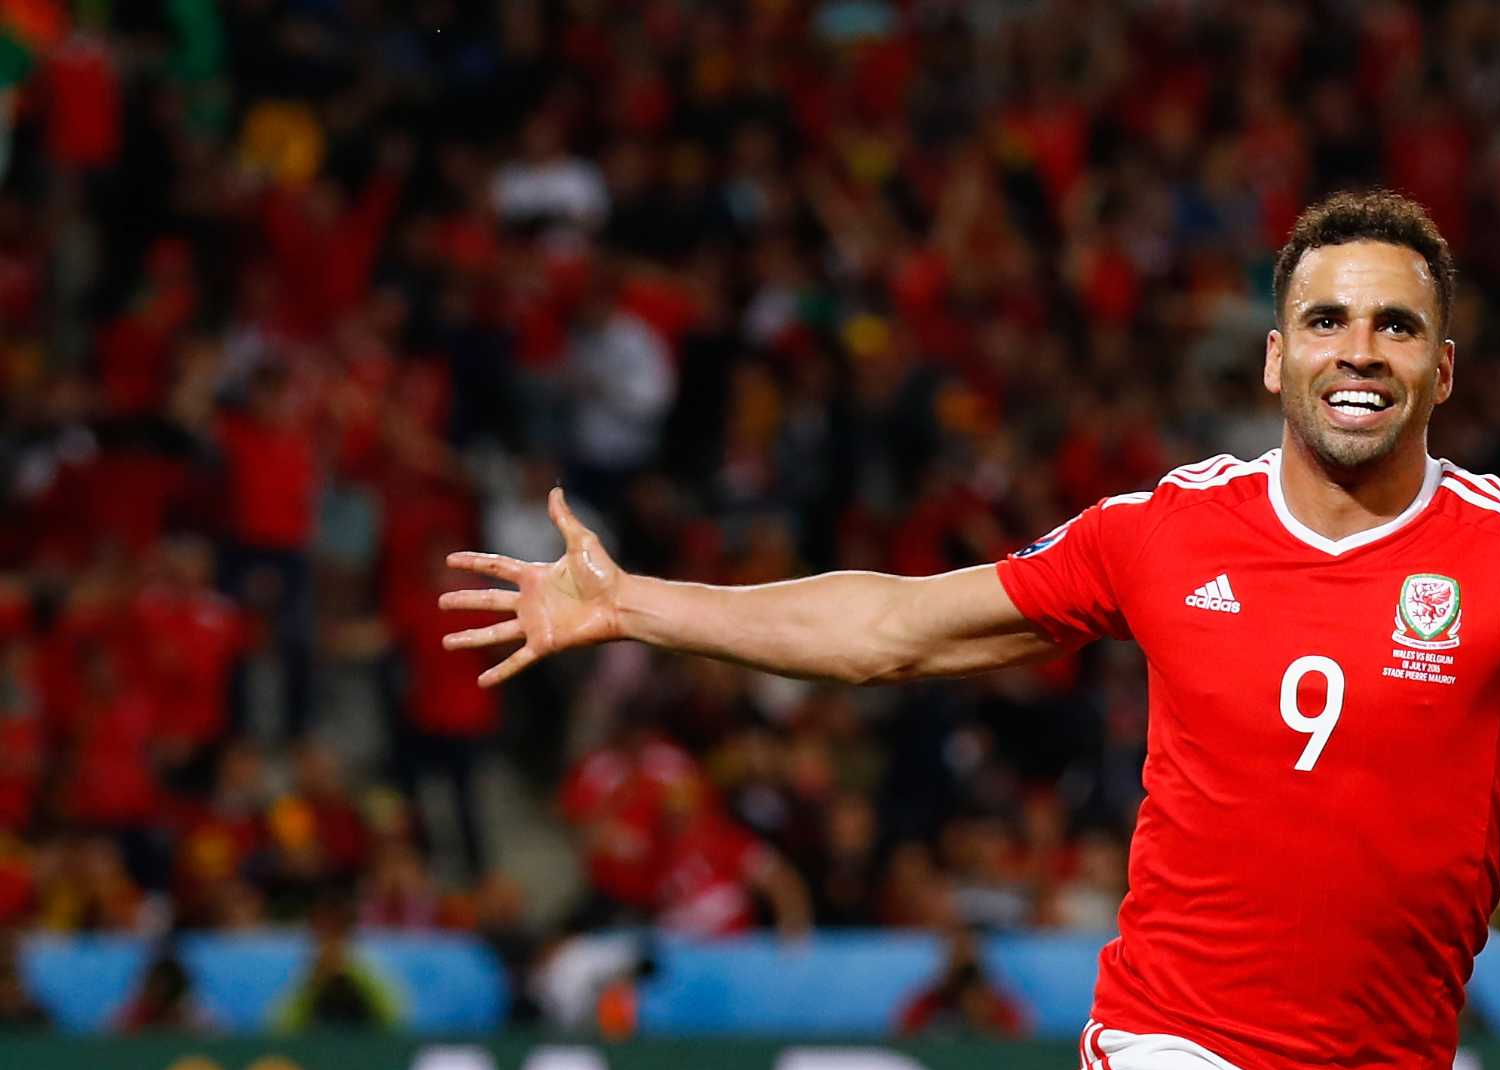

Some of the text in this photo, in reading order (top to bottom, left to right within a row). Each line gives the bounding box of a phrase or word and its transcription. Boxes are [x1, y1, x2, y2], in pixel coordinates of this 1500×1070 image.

[1185, 592, 1241, 614] adidas
[1392, 649, 1454, 664] WALES VS BELGIUM
[1382, 667, 1456, 685] STADE PIERRE MAUROY
[1409, 661, 1427, 671] JULY
[1427, 663, 1441, 674] 2016
[1279, 655, 1345, 772] 9
